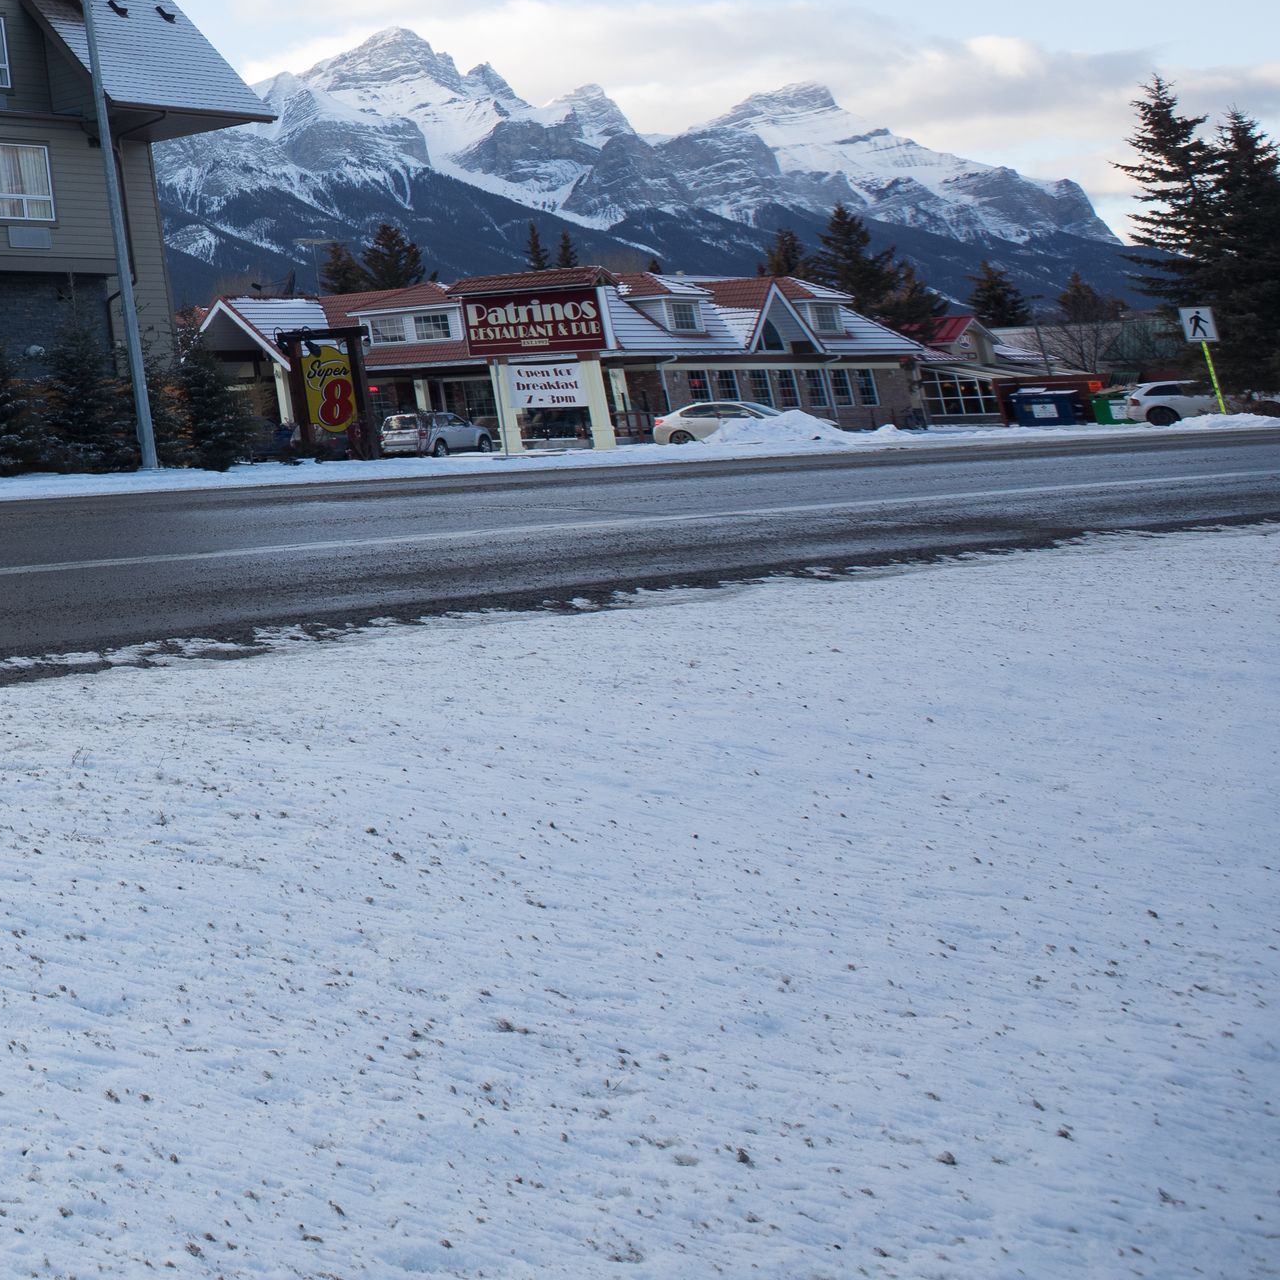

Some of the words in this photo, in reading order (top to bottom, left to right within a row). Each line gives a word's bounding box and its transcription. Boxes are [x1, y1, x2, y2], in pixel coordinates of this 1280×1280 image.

[466, 299, 597, 326] Patrinos
[470, 324, 553, 341] RESTAURANT
[557, 322, 569, 336] &
[571, 321, 600, 335] PUB
[307, 360, 350, 388] Super
[517, 368, 550, 378] Open
[553, 367, 572, 377] for
[516, 380, 579, 391] breakfast
[319, 379, 353, 426] 8
[524, 394, 533, 404] 7
[547, 394, 576, 404] 3pm
